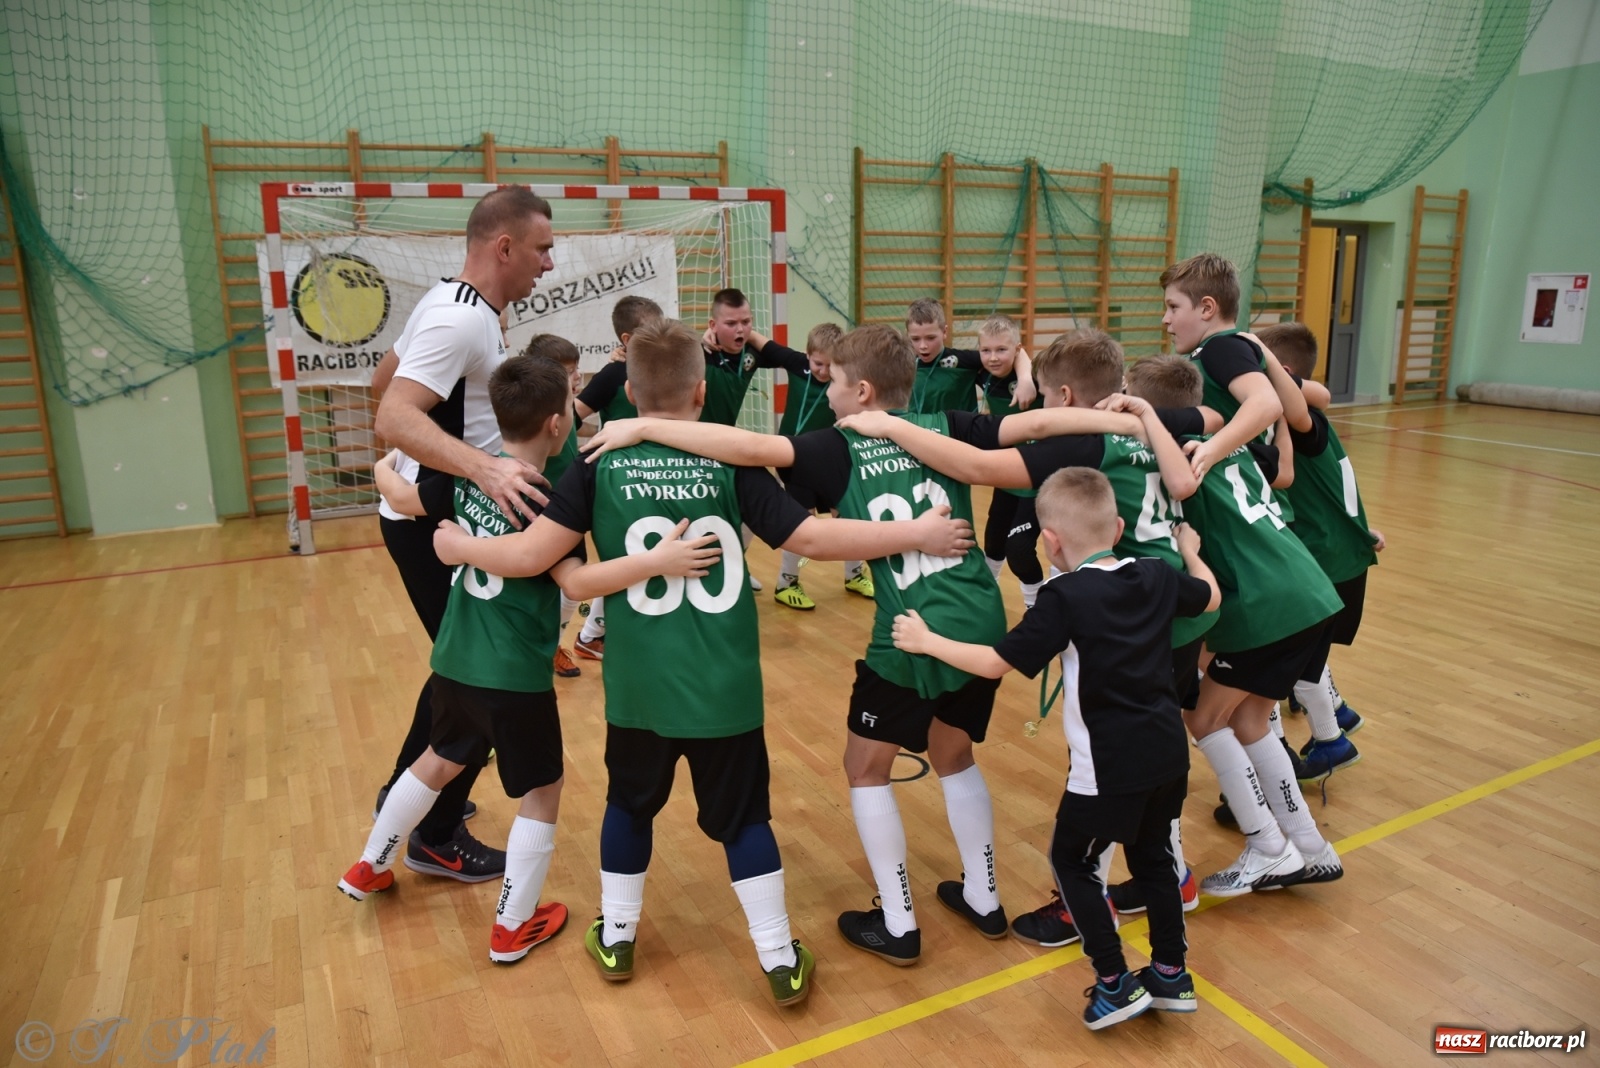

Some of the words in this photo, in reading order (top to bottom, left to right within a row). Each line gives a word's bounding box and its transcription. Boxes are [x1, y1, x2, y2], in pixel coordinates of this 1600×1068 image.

[512, 256, 656, 321] PORZĄDKU!
[297, 347, 388, 372] RACIBÓR
[625, 515, 744, 616] 80
[897, 863, 912, 912] TWORKOW
[984, 844, 996, 893] TWORKOW
